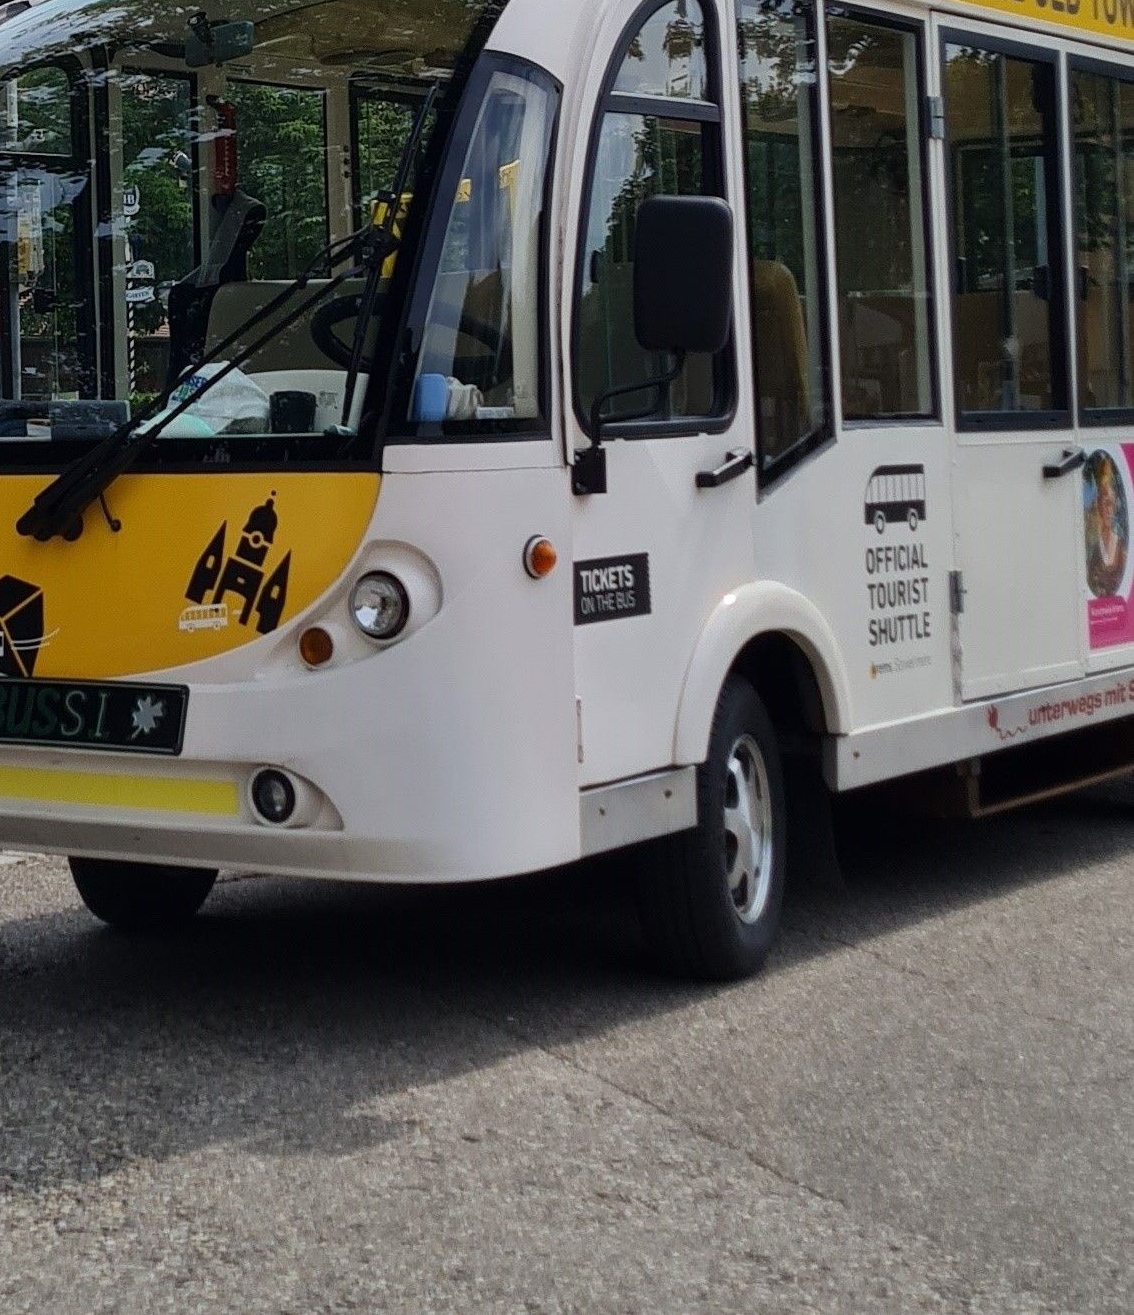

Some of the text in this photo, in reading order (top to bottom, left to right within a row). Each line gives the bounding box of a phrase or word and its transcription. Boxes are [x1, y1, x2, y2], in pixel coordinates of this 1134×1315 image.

[866, 543, 928, 574] OFFICIAL
[579, 564, 634, 594] TICKETS
[867, 577, 928, 610] TOURIST
[580, 589, 635, 615] ON THE BUS
[869, 611, 931, 647] SHUTTLE
[1028, 692, 1102, 725] unterwegs
[1105, 683, 1126, 706] mit
